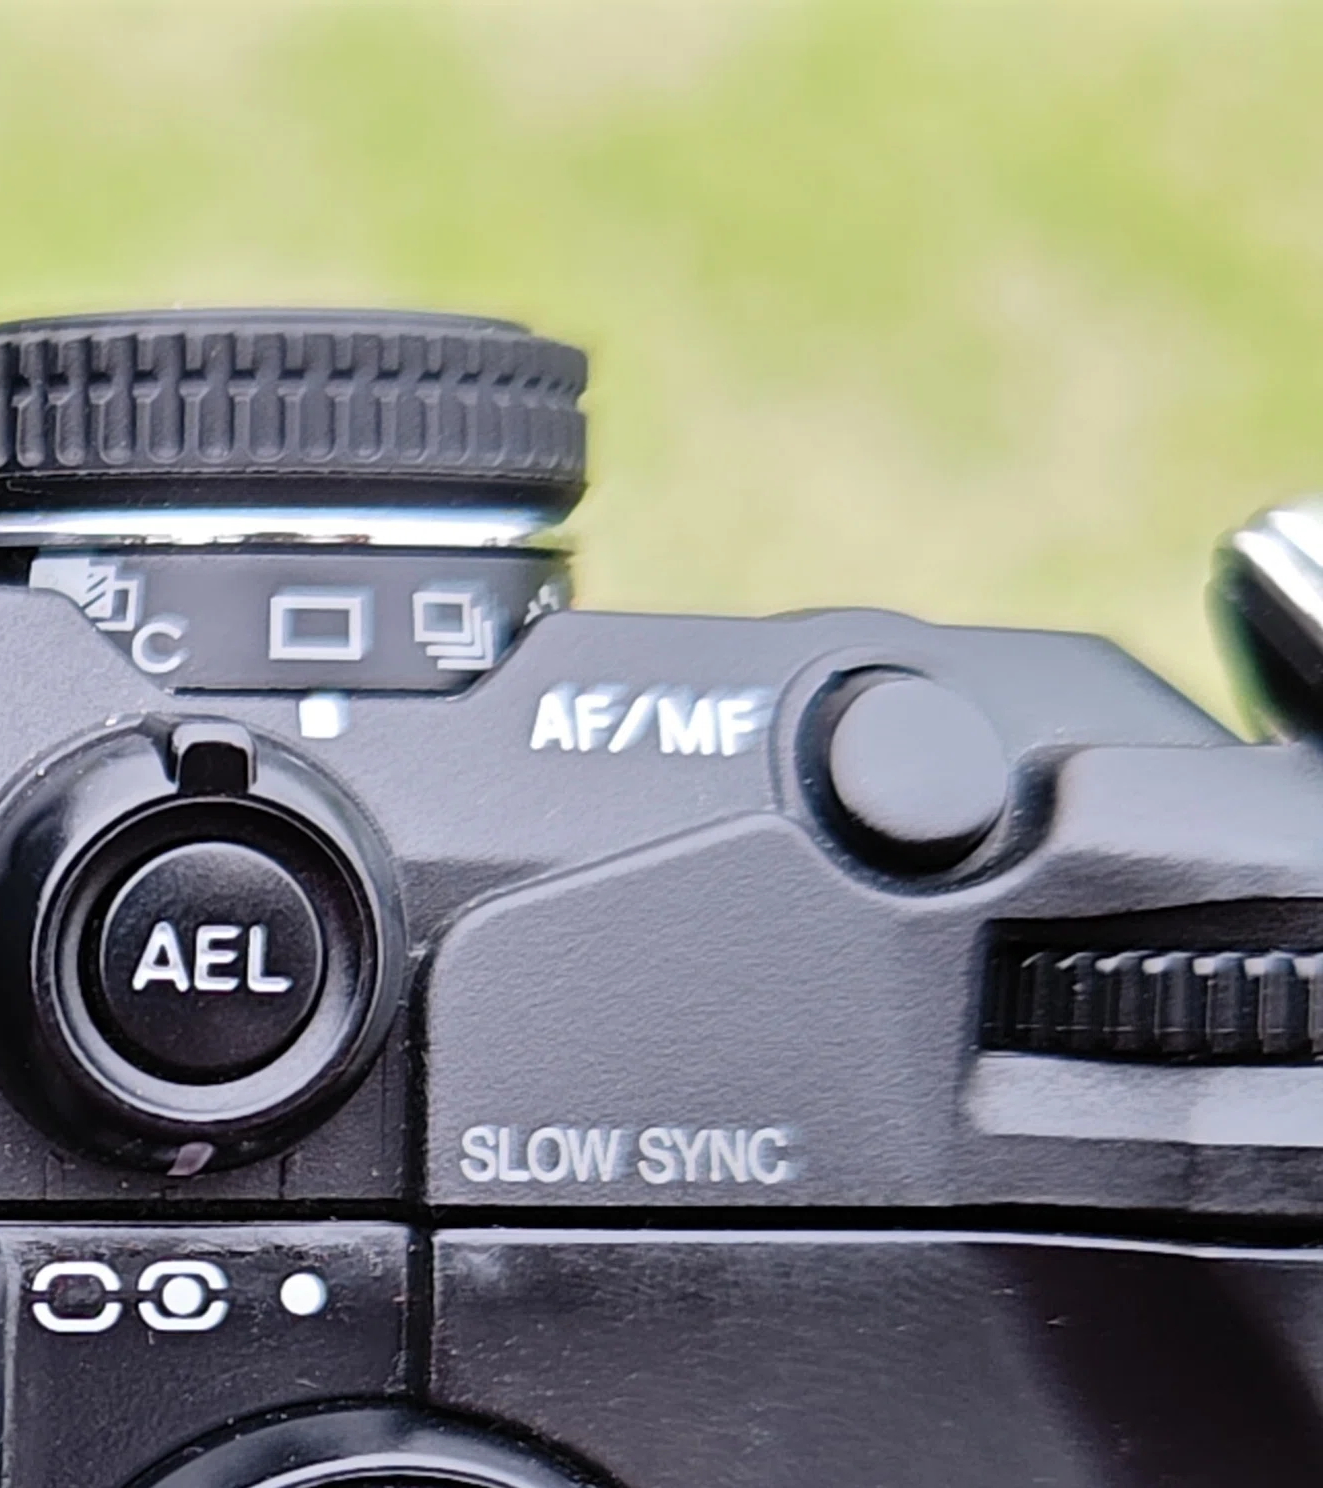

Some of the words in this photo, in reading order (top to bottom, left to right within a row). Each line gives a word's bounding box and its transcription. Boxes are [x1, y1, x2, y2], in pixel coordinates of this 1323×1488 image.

[529, 688, 767, 757] AF/MF
[131, 922, 292, 993] AEL
[459, 1124, 625, 1184] SLOW
[636, 1124, 793, 1186] SYNC
